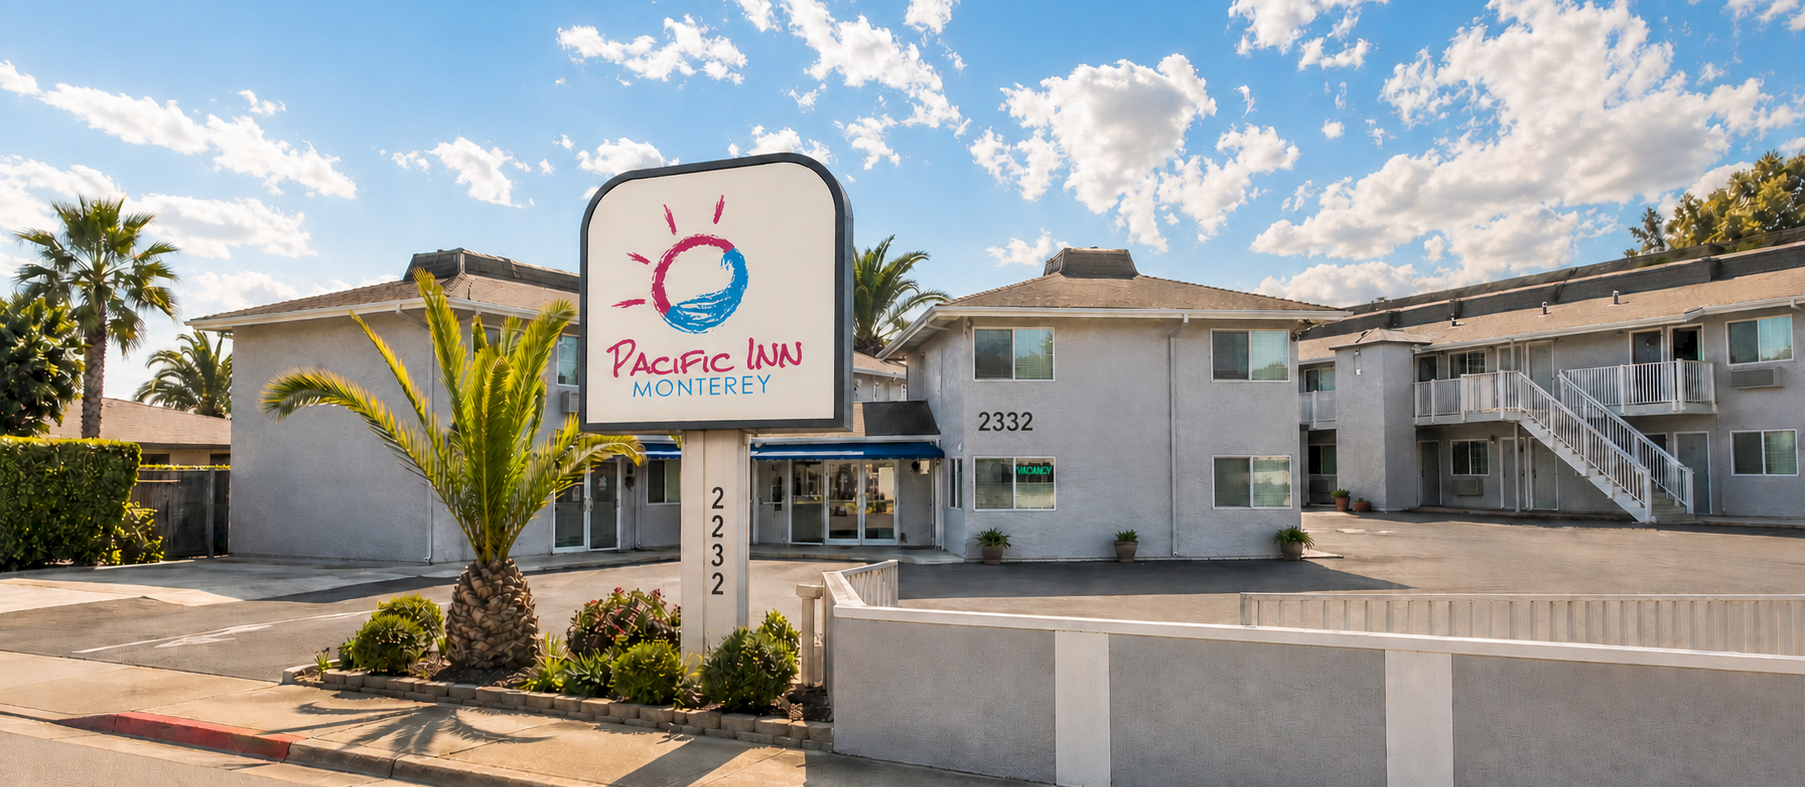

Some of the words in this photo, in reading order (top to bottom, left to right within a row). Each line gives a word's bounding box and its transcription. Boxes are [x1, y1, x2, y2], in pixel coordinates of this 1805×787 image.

[606, 338, 735, 378] PACIFIC
[746, 336, 803, 371] INN
[632, 373, 772, 397] MONTEREY
[978, 411, 1033, 431] 2332
[711, 486, 724, 596] 2232
